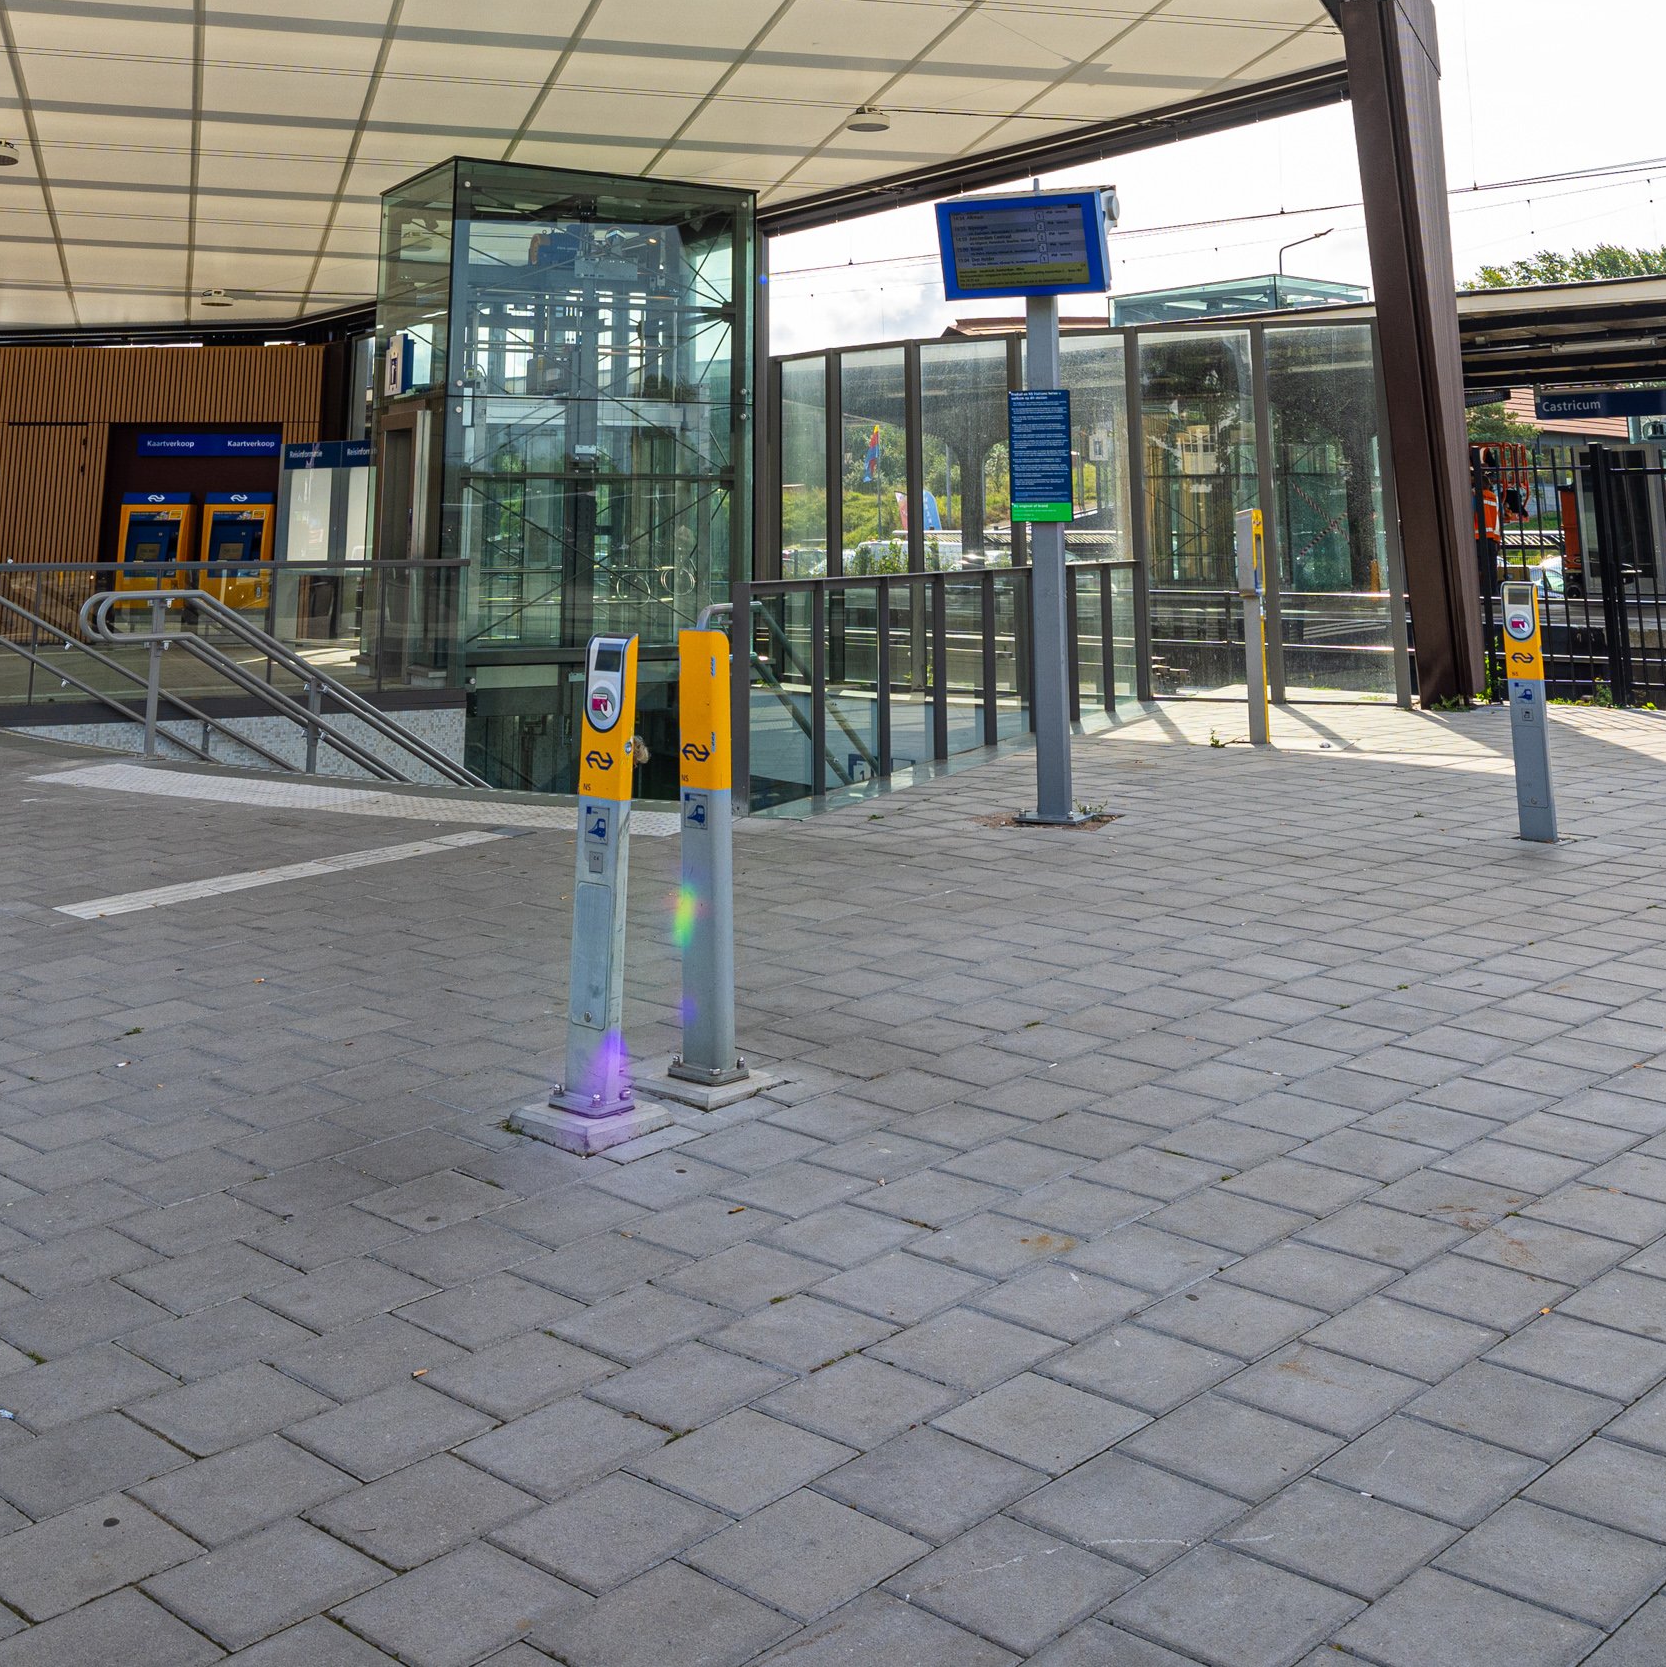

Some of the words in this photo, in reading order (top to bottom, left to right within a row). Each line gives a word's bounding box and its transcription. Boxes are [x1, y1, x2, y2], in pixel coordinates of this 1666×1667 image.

[1542, 399, 1601, 413] Castricum
[147, 440, 195, 448] Kaartverkoop
[227, 440, 275, 448] Kaartverkoop
[681, 774, 689, 782] NS
[582, 783, 591, 791] NS
